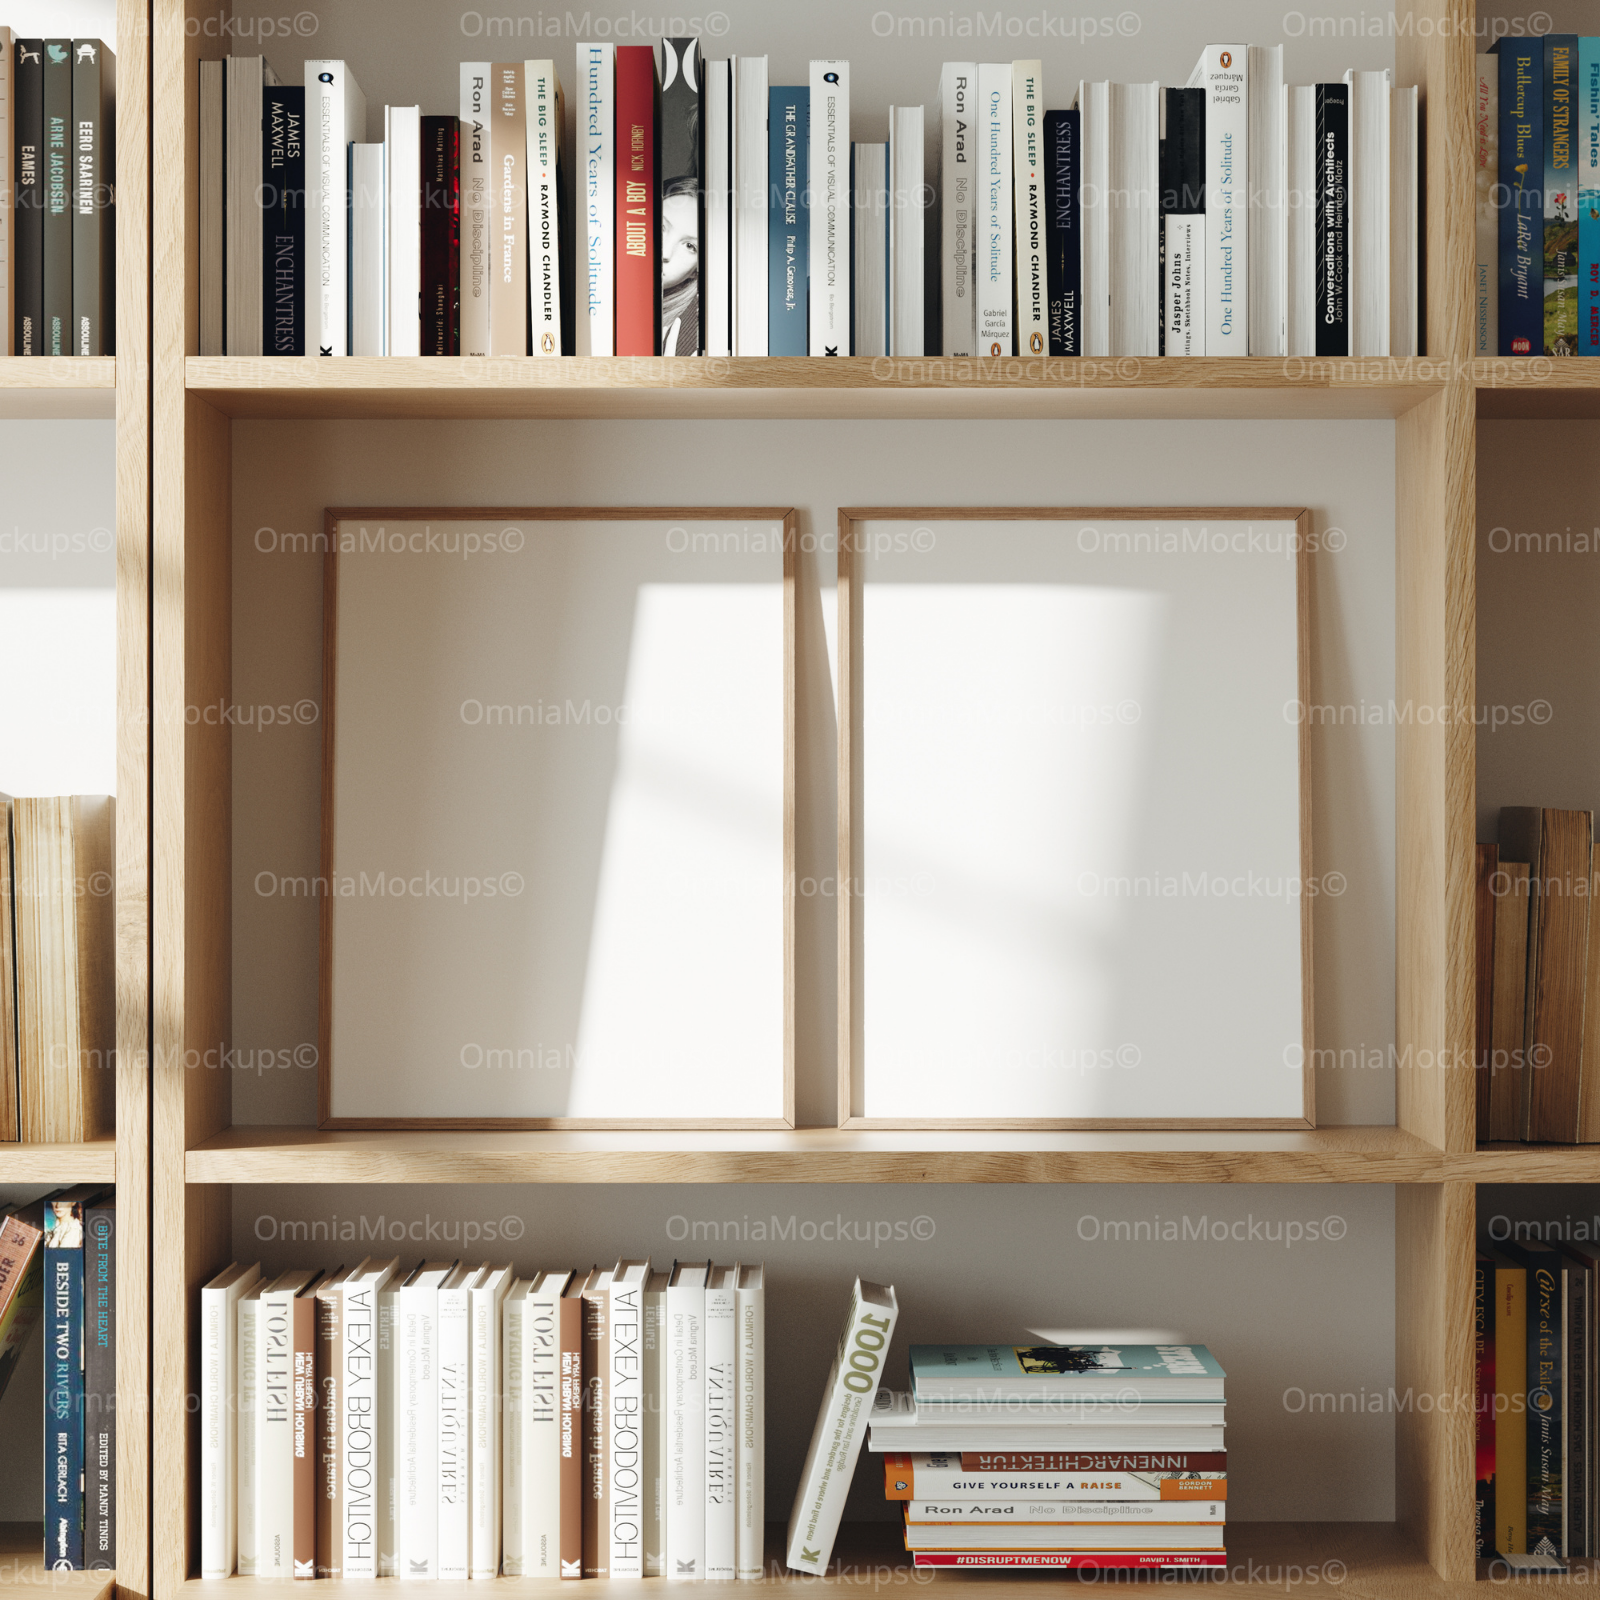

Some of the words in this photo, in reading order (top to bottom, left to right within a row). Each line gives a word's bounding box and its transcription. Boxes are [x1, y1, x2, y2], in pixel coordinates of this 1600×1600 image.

[1210, 73, 1244, 82] Márquez
[1552, 47, 1570, 87] FAMILY
[472, 76, 484, 113] Ron
[537, 77, 545, 100] THE
[589, 48, 602, 137] Hundred
[956, 76, 967, 114] Ron
[1026, 77, 1034, 100] THE
[1214, 84, 1239, 93] García
[1510, 56, 1531, 118] Buttercup
[1552, 89, 1570, 104] OF
[1590, 62, 1600, 119] Fishin'
[538, 104, 546, 127] BIG
[785, 104, 796, 122] THE
[990, 91, 1001, 120] One
[1027, 104, 1036, 127] BIG
[50, 117, 64, 148] ARNE
[78, 121, 93, 151] EERO
[271, 101, 284, 169] MAXWELL
[287, 112, 300, 158] JAMES
[472, 119, 484, 164] Arad
[631, 123, 644, 151] HORNBY
[827, 96, 835, 152] ESSENTIALS
[956, 119, 967, 163] Arad
[1516, 122, 1532, 158] Blues
[1552, 105, 1570, 169] STRANGERS
[538, 132, 548, 167] SLEEP
[785, 124, 796, 189] GRANDFATHER
[827, 154, 835, 168] OF
[990, 121, 1001, 175] Hundred
[1027, 132, 1037, 167] SLEEP
[1220, 132, 1232, 185] Solitude
[1590, 122, 1600, 168] Tales
[21, 145, 36, 185] EAMES
[589, 142, 602, 198] Years
[631, 154, 644, 172] NICK
[1056, 121, 1072, 229] ENCHANTRESS
[1325, 131, 1335, 198] Architects
[1335, 160, 1344, 184] Klotz
[50, 152, 64, 213] JACOBSEN
[78, 155, 93, 215] SAARINEN
[472, 177, 484, 204] No
[503, 154, 515, 213] Gardens
[626, 180, 646, 203] BOY
[827, 170, 835, 203] VISUAL
[956, 177, 968, 203] No
[990, 179, 1001, 212] Years
[1220, 189, 1232, 204] of
[503, 216, 515, 231] in
[540, 184, 550, 250] RAYMOND
[589, 204, 602, 228] of
[626, 207, 646, 216] A
[785, 190, 796, 225] CLAUSE
[990, 214, 1001, 231] of
[1028, 184, 1039, 250] RAYMOND
[1220, 207, 1232, 243] Years
[1325, 200, 1335, 228] with
[1335, 186, 1344, 229] Heinrich
[626, 220, 646, 257] ABOUT
[827, 204, 835, 286] COMMUNICATION
[1335, 231, 1344, 252] and
[1516, 213, 1532, 251] LaRee
[470, 209, 484, 298] Discipline
[503, 234, 515, 283] France
[954, 209, 968, 298] Discipline
[990, 233, 1001, 282] Solitude
[1172, 252, 1182, 289] Johns
[542, 254, 552, 322] CHANDLER
[588, 236, 602, 316] Solitude
[1030, 254, 1041, 322] CHANDLER
[1220, 246, 1232, 303] Hundred
[1325, 231, 1335, 324] Conversations
[1477, 263, 1488, 294] JANET
[1510, 254, 1532, 300] Bryant
[1590, 263, 1600, 284] ROY
[275, 234, 294, 351] ENCHANTRESS
[1335, 296, 1344, 323] John
[1590, 289, 1600, 299] D.
[984, 309, 1007, 318] Gabriel
[985, 319, 1006, 328] García
[1051, 300, 1062, 343] JAMES
[1064, 290, 1074, 352] MAXWELL
[1172, 292, 1182, 334] Jasper
[1220, 307, 1232, 336] One
[1479, 296, 1487, 350] NISSENSON
[1590, 306, 1600, 347] MERCER
[981, 329, 1009, 339] Márquez
[98, 1224, 108, 1251] BITE
[98, 1253, 108, 1284] FROM
[56, 1261, 70, 1318] BESIDE
[98, 1285, 108, 1309] THE
[1535, 1268, 1556, 1319] Curse
[56, 1320, 70, 1359] TWO
[98, 1310, 108, 1348] HEART
[1540, 1320, 1552, 1334] of
[1540, 1337, 1550, 1356] the
[56, 1362, 70, 1420] RIVERS
[1540, 1360, 1554, 1392] Exile
[57, 1432, 67, 1454] RITA
[1539, 1412, 1552, 1444] Janis
[99, 1432, 108, 1468] EDITED
[979, 1455, 1188, 1470] INNENARCHITEKTUR
[1540, 1447, 1552, 1480] Susan
[57, 1456, 67, 1502] GERLACH
[99, 1470, 108, 1482] BY
[953, 1481, 985, 1490] GIVE
[990, 1481, 1060, 1490] YOURSELF
[1066, 1481, 1075, 1490] A
[1080, 1481, 1122, 1490] RAISE
[99, 1484, 108, 1517] MANDY
[925, 1506, 962, 1514] Ron
[969, 1506, 1014, 1514] Arad
[1029, 1506, 1056, 1514] No
[1062, 1506, 1153, 1515] Discipline
[1536, 1484, 1552, 1516] May
[99, 1519, 108, 1551] TINICS
[956, 1556, 1072, 1565] #DISRUPTMENOW
